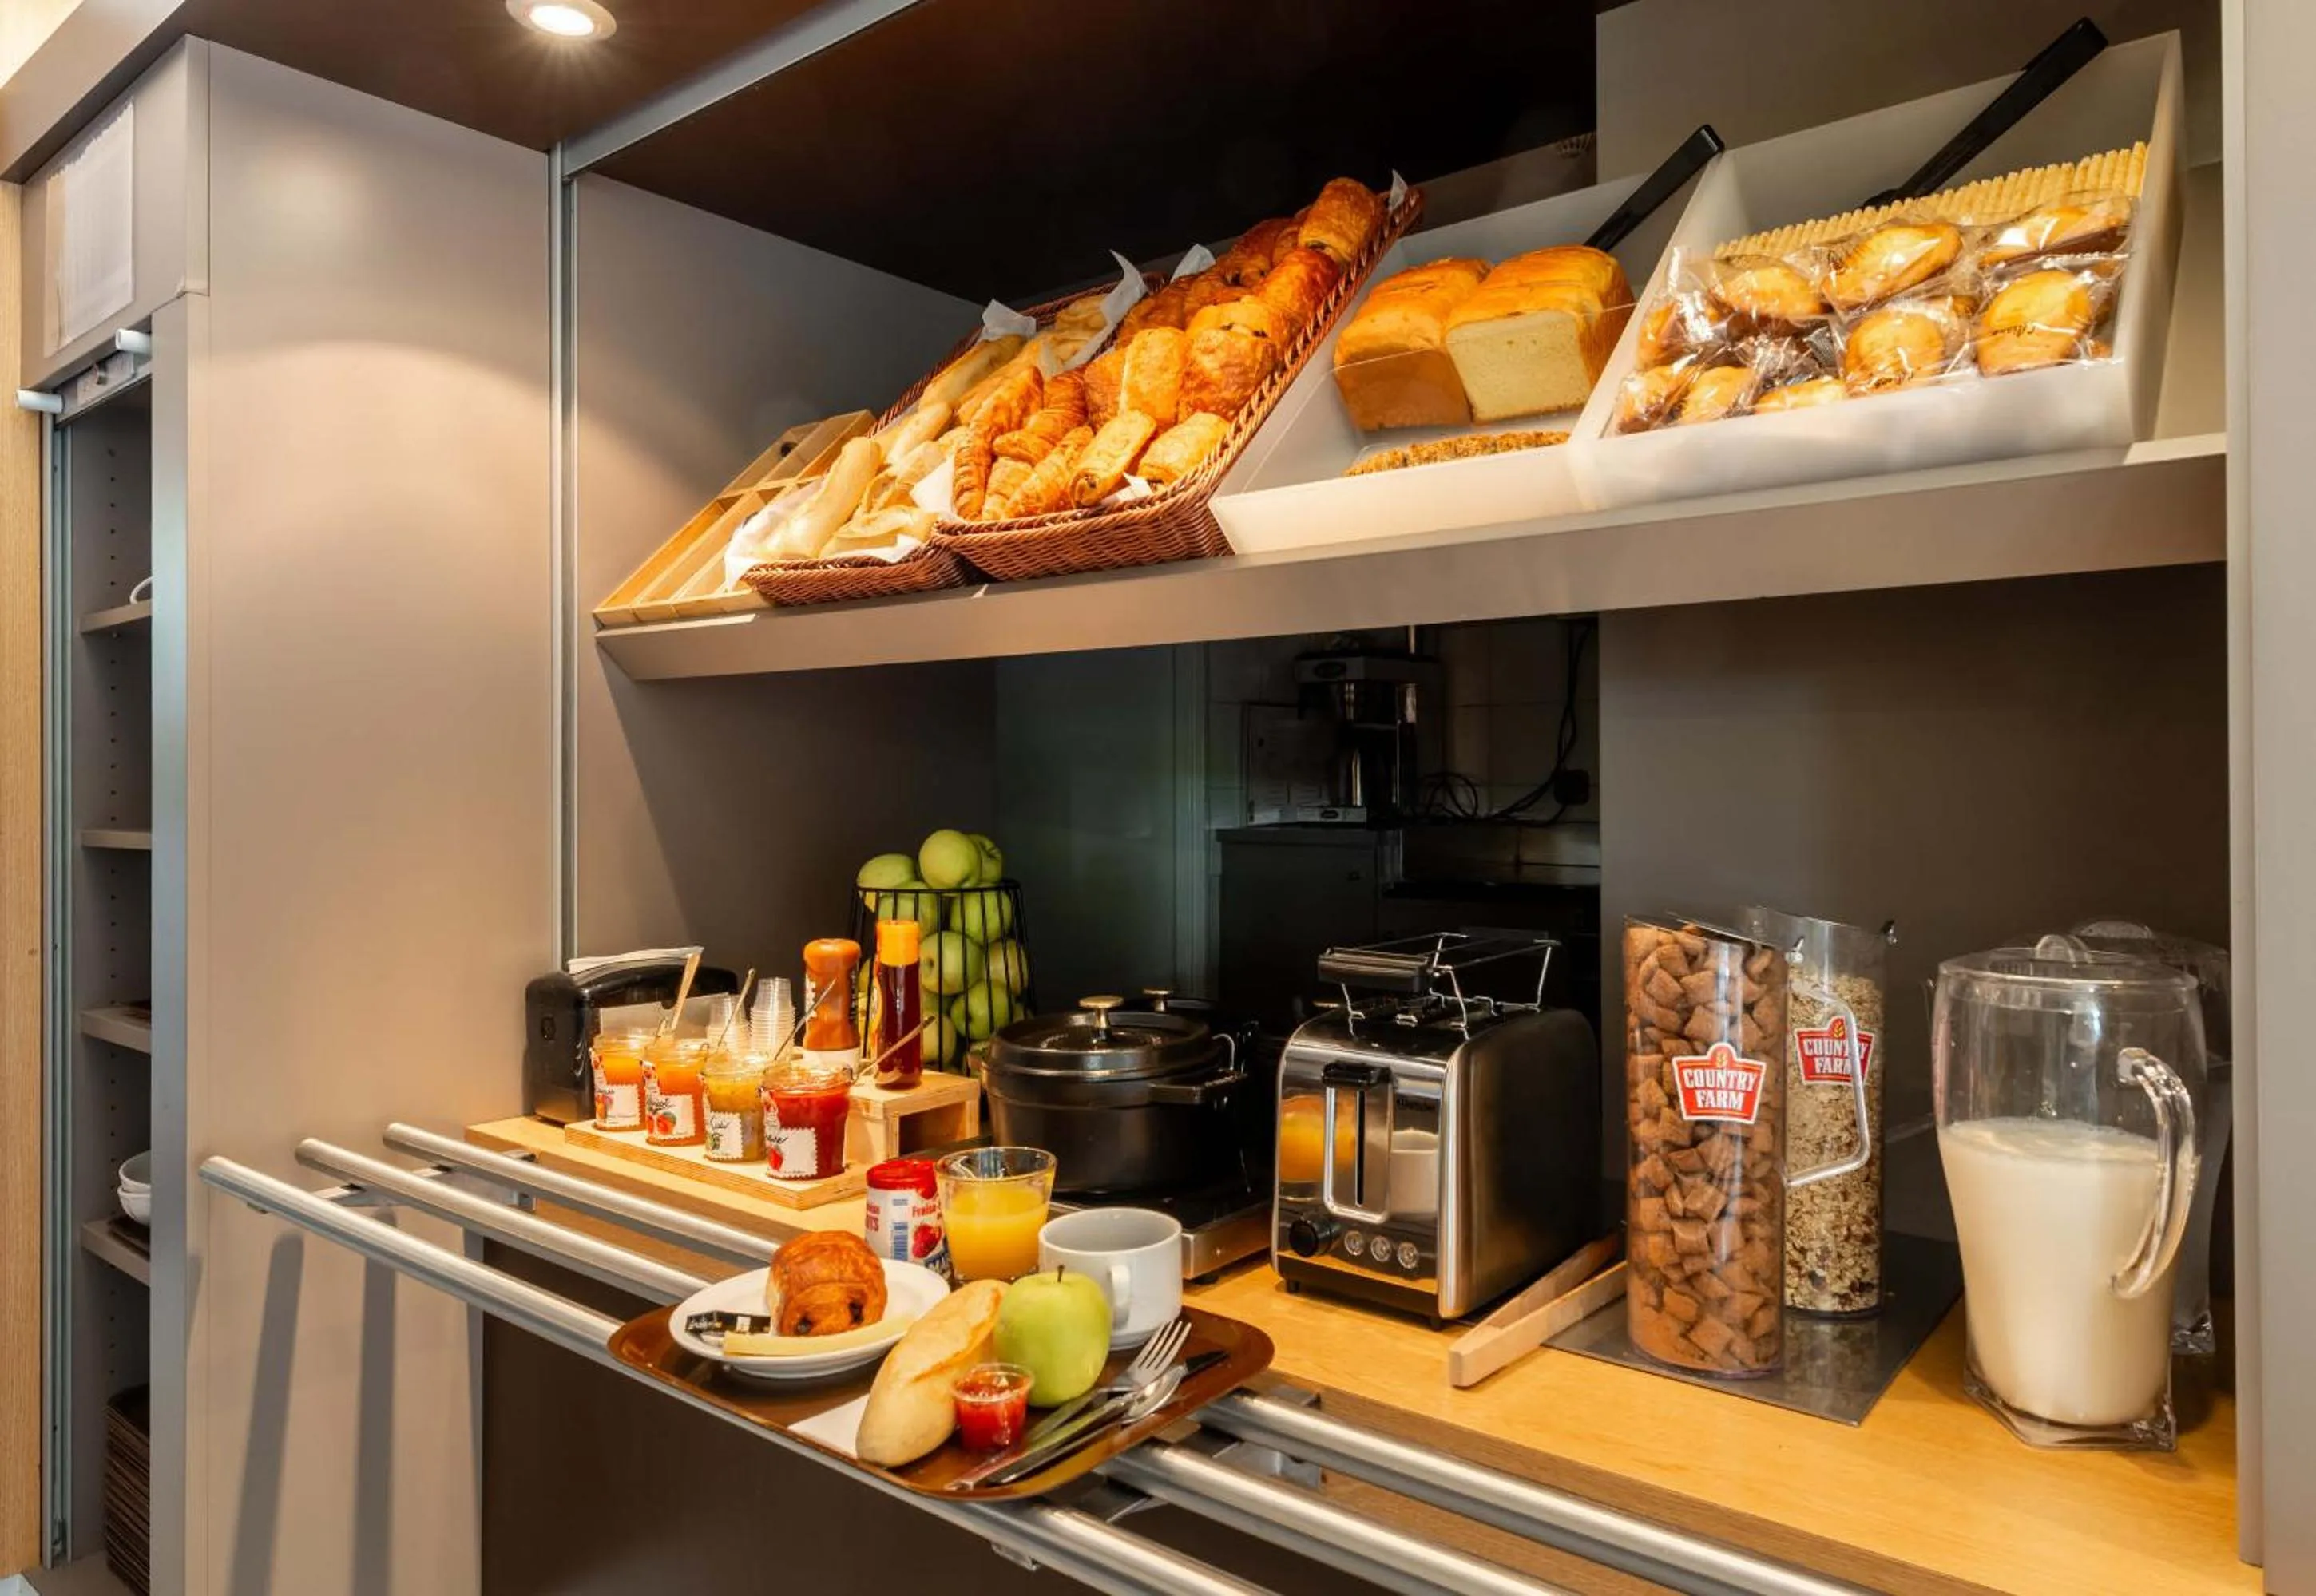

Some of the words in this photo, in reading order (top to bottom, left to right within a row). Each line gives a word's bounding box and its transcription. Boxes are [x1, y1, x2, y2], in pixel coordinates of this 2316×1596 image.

[1803, 1038, 1869, 1059] COUNTY
[1683, 1068, 1758, 1091] COUNTRY
[1695, 1089, 1744, 1111] FARM
